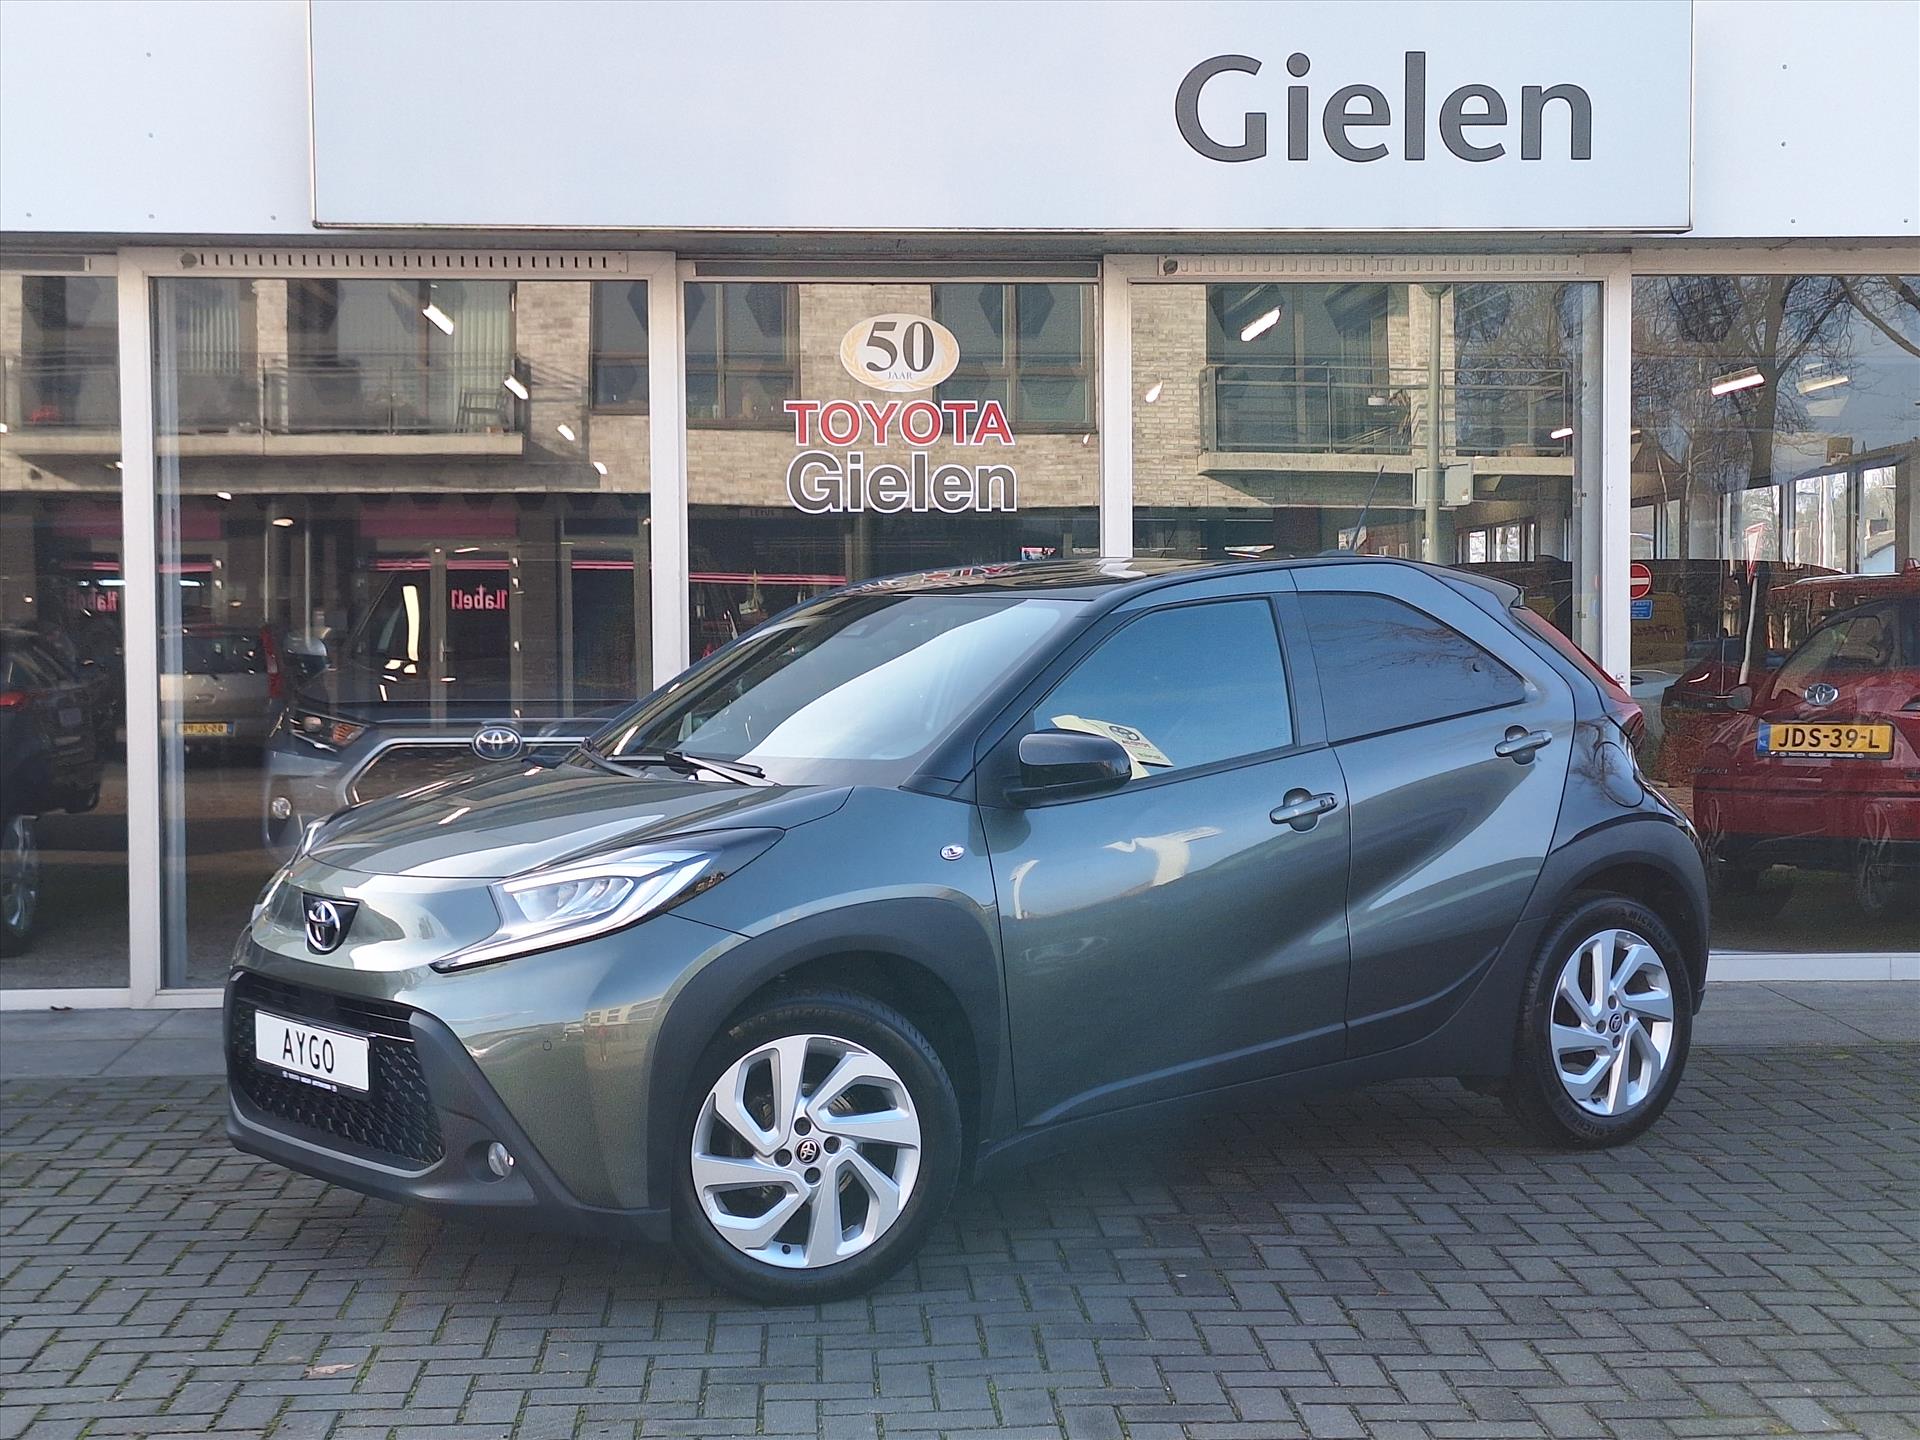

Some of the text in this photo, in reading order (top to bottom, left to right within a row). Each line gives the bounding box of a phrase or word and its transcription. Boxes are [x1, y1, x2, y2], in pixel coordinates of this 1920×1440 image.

[1175, 51, 1592, 162] Gielen
[866, 321, 934, 372] 50
[887, 371, 912, 380] JAAR
[784, 400, 1016, 446] TOYOTA
[787, 450, 1018, 513] Gielen
[1778, 727, 1880, 749] JDS-39-L
[283, 1028, 335, 1073] AYGO
